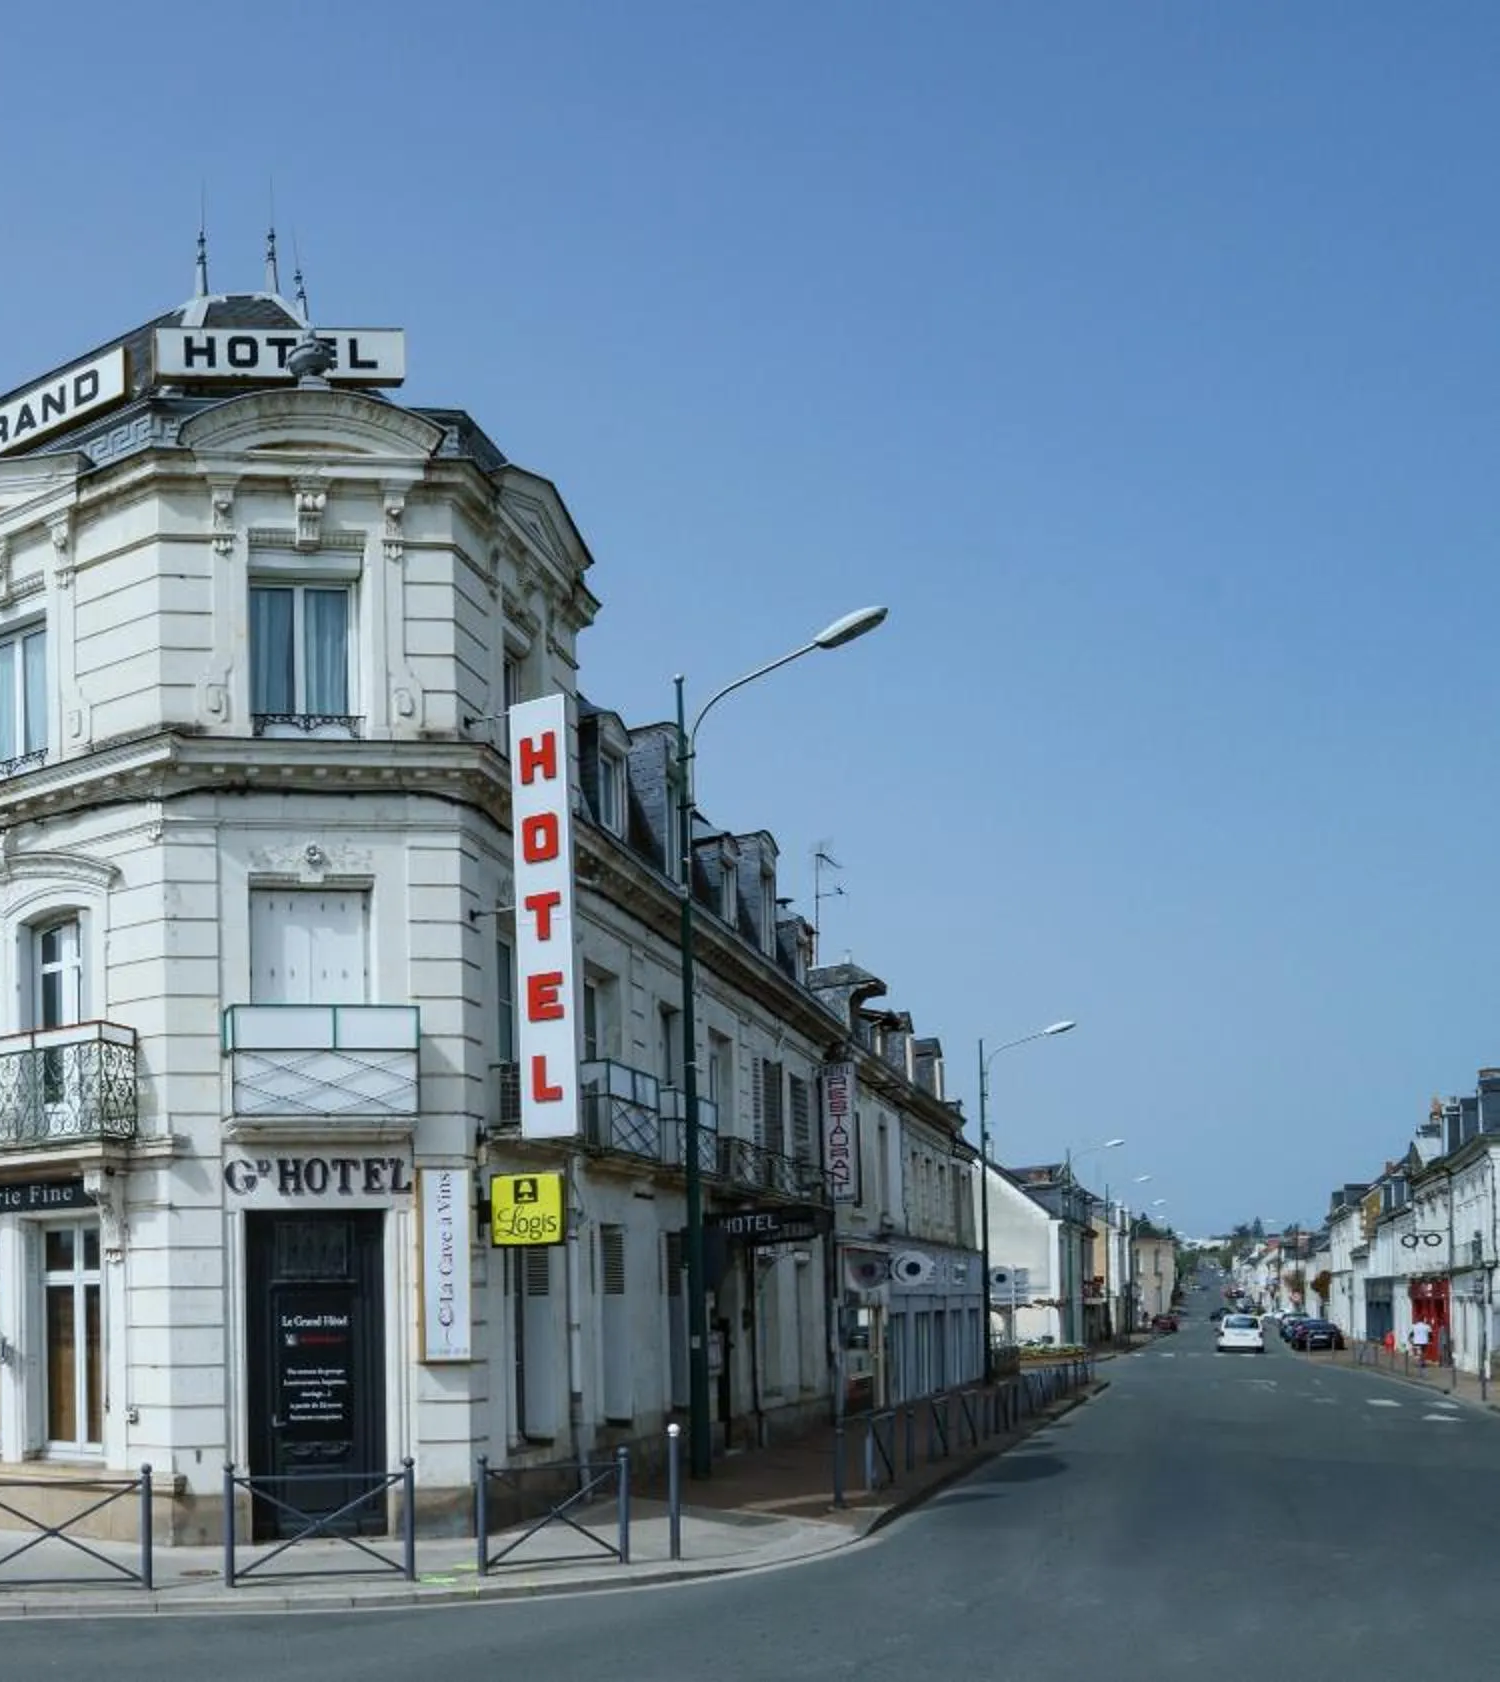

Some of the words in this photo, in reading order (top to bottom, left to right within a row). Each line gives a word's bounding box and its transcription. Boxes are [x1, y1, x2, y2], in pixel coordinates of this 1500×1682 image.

[518, 730, 565, 1103] HOTEL
[29, 1183, 74, 1204] Fine
[276, 1157, 413, 1197] HOTEL
[437, 1172, 452, 1214] Vins
[495, 1205, 557, 1240] Logis
[439, 1230, 454, 1277] Cave
